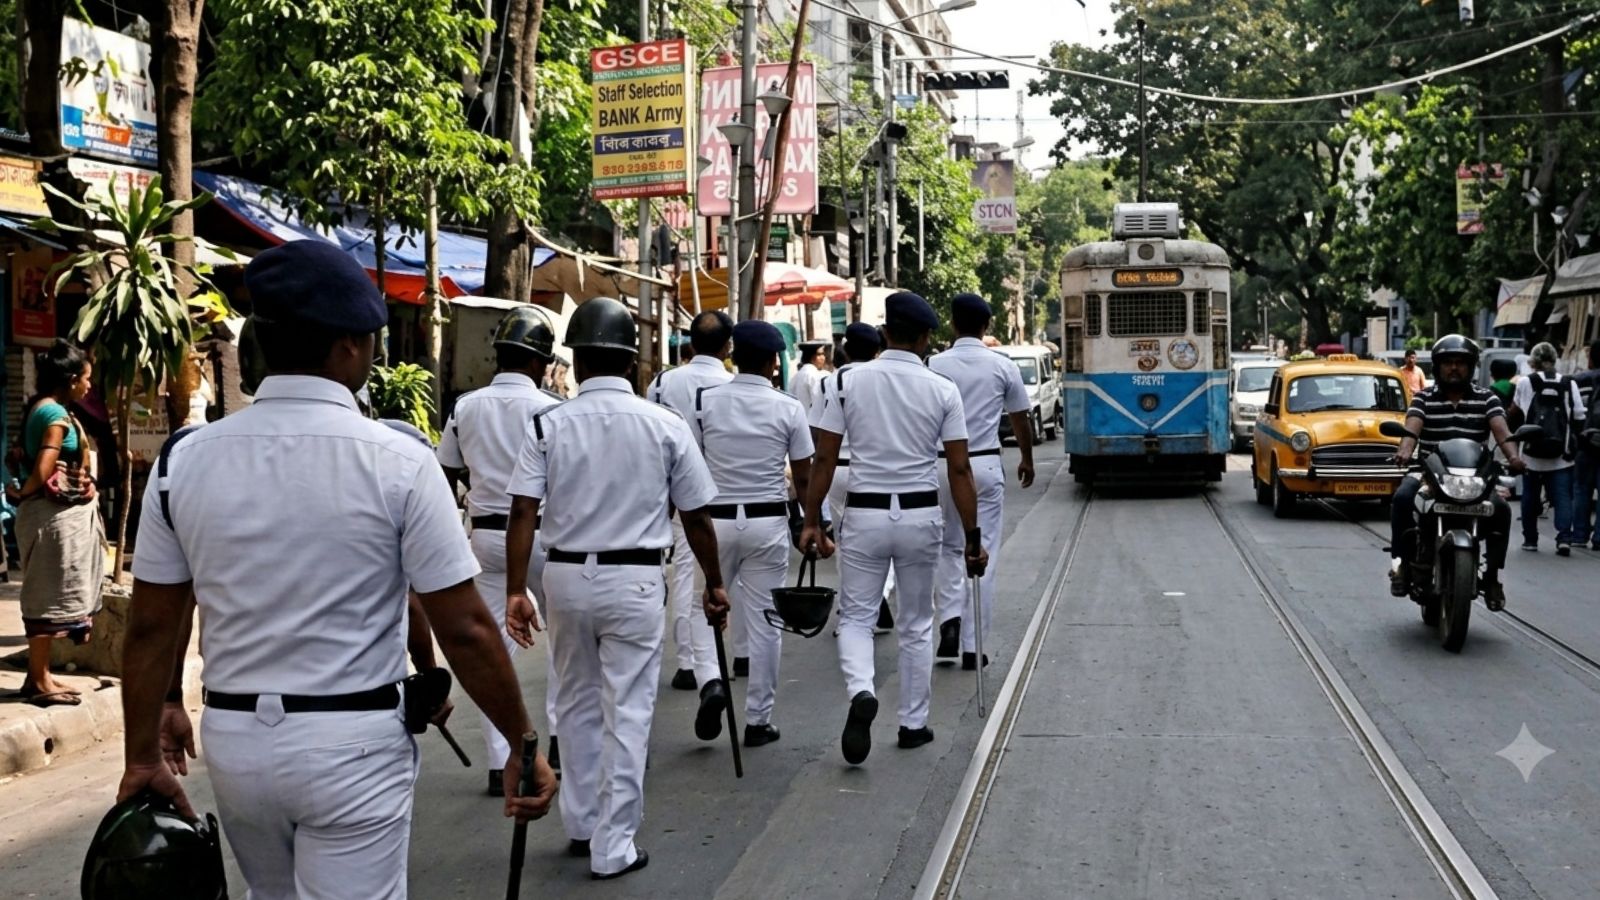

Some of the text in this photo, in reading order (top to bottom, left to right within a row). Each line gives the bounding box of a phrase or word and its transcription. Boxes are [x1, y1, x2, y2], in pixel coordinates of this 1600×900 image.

[595, 43, 680, 69] GSCE
[598, 84, 627, 103] Staff
[628, 80, 682, 100] Selection
[599, 105, 683, 128] BANK Army
[979, 203, 1013, 219] STCN
